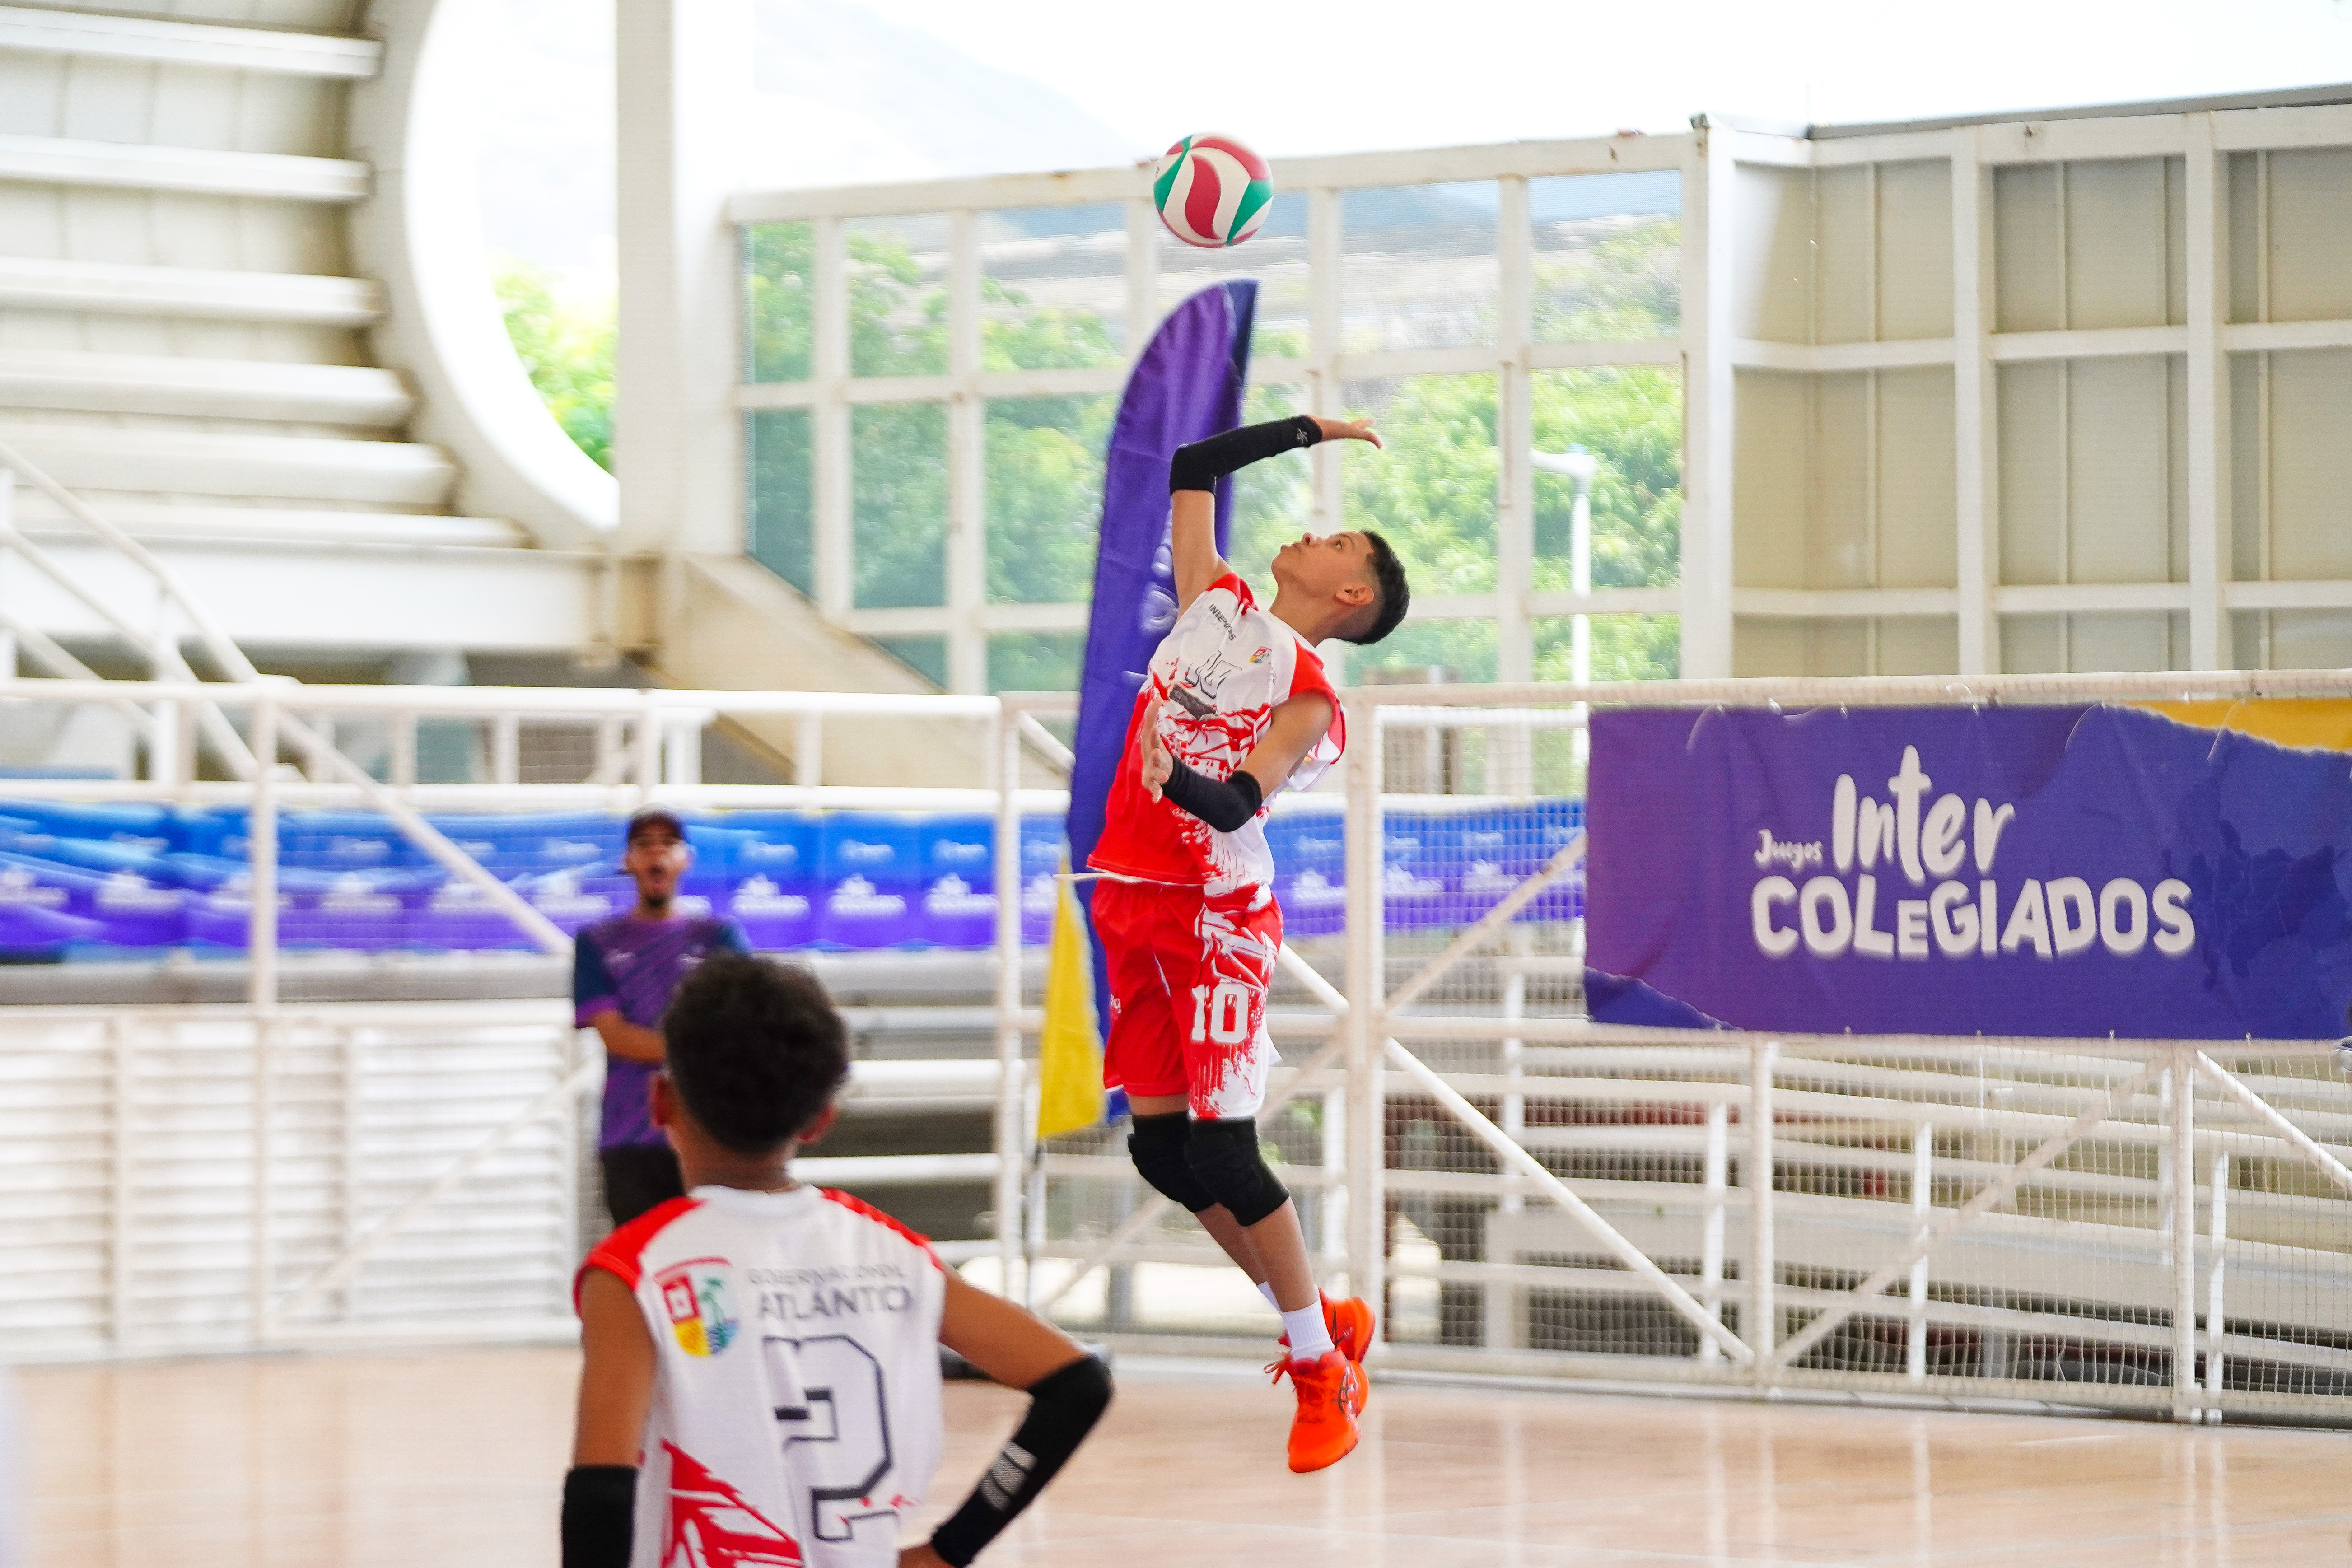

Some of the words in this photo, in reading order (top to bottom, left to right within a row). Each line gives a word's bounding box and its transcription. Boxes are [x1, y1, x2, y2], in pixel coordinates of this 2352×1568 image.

[1753, 827, 1824, 870] Juegos
[1831, 744, 2016, 885] Inter
[1750, 873, 2197, 961] COLEGIADOS
[1191, 982, 1249, 1044] 10
[761, 1332, 898, 1542] 2
